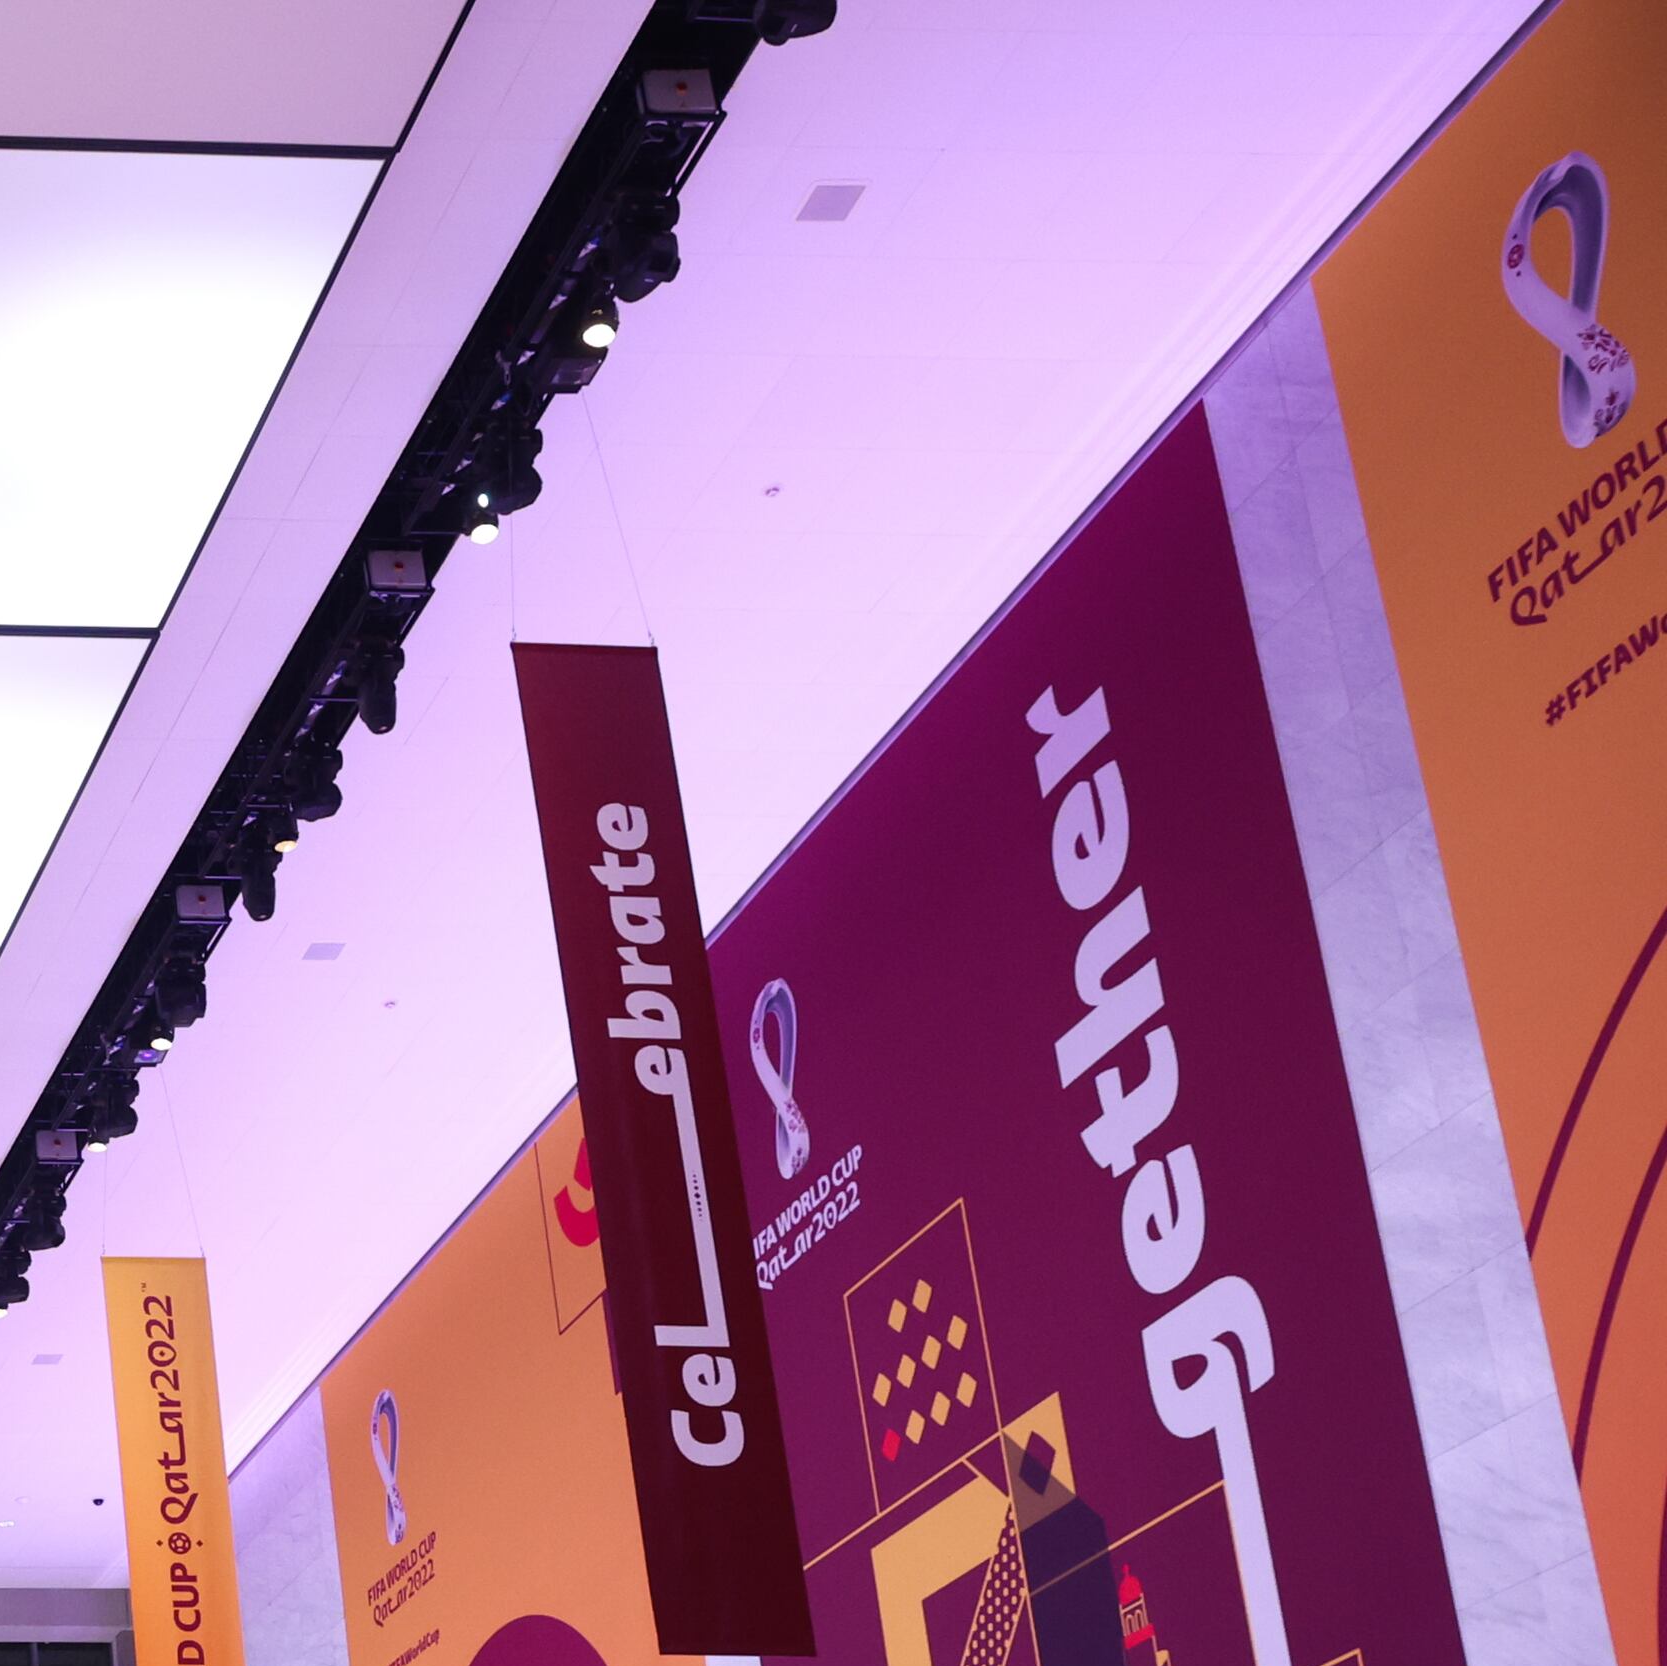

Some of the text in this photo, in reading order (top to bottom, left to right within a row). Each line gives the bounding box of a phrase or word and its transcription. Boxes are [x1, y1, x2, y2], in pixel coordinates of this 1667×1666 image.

[1488, 527, 1559, 602] FIFA
[752, 1144, 863, 1259] IFA WORLD CUP
[756, 1181, 861, 1290] Qatar2022
[141, 1294, 199, 1525] Qatar2022
[170, 1562, 202, 1633] CUP
[367, 1531, 436, 1607] FIFA WORLD CUP
[373, 1558, 436, 1628] Qatar2022
